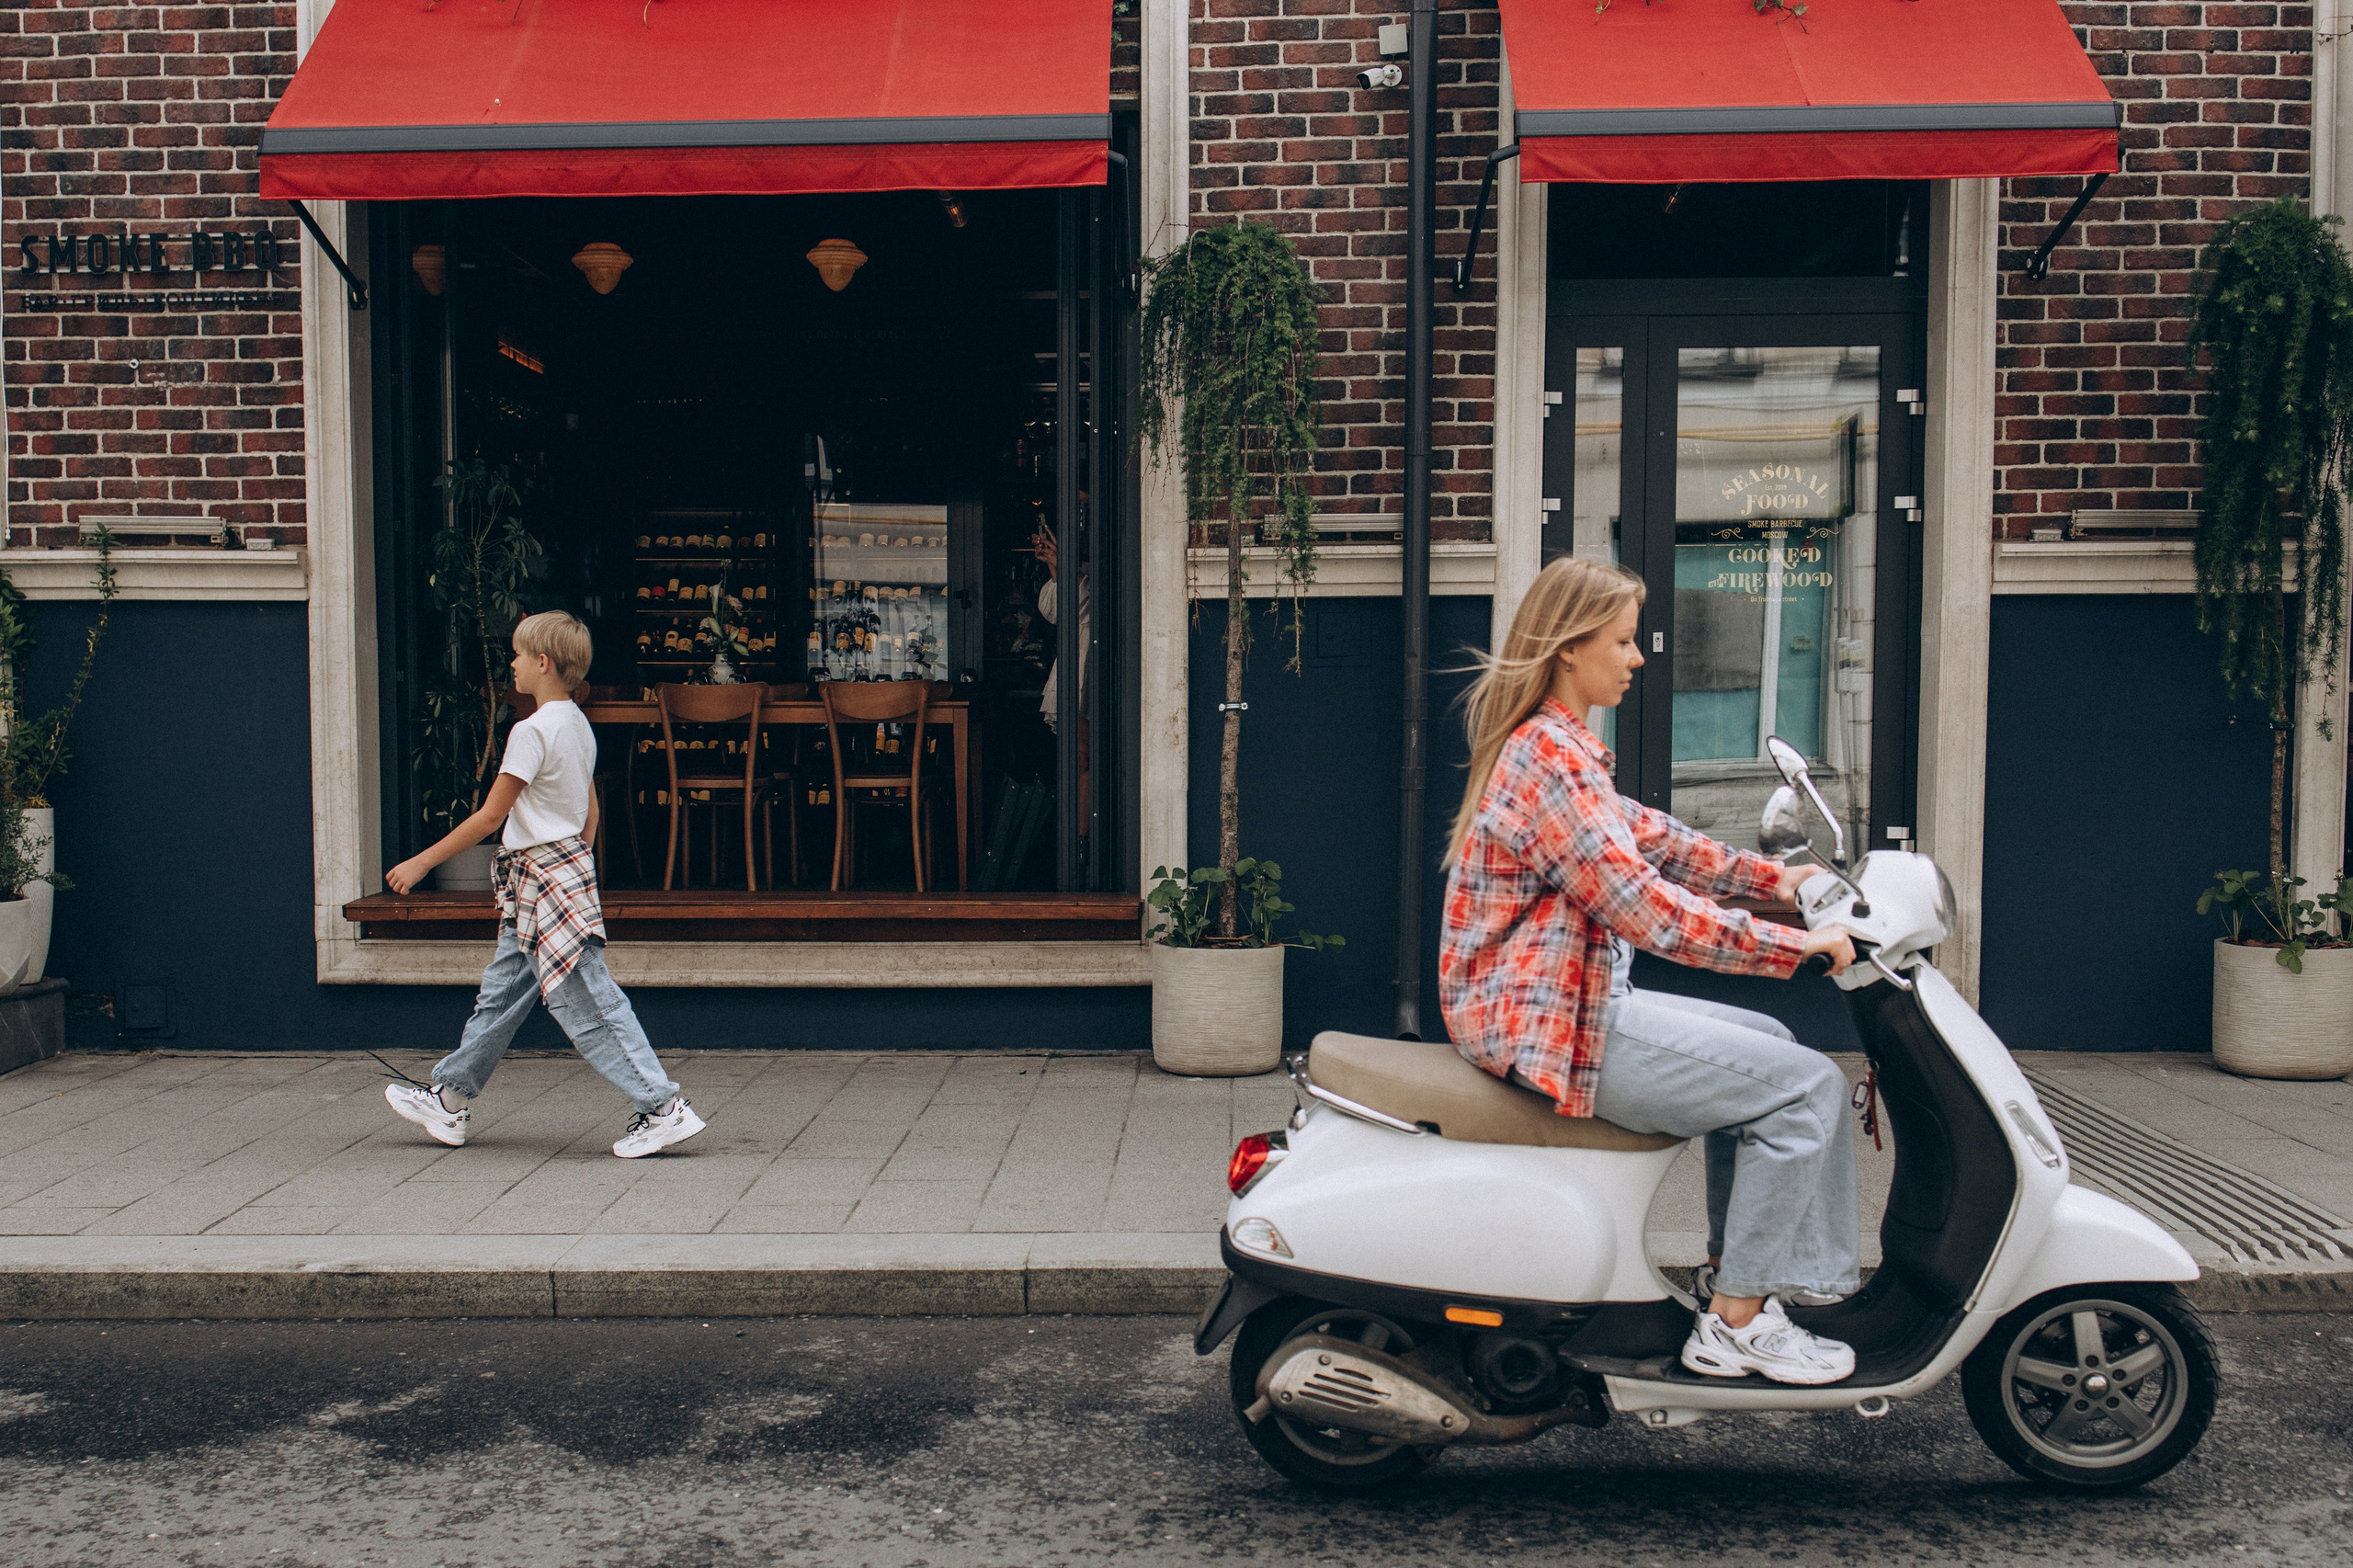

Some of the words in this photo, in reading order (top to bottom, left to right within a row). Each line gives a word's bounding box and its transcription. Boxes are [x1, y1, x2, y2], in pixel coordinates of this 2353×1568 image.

[20, 233, 170, 275] SMOKE
[191, 230, 281, 271] BBQ
[21, 295, 58, 309] БАР
[71, 292, 139, 308] ГРИЛЬ
[1722, 462, 1829, 500] SEASONAL
[1740, 494, 1809, 516] FOOD
[1747, 519, 1769, 528] SMOKE
[1770, 519, 1802, 528] BARBECUE
[1761, 530, 1789, 540] MOSCOW
[1728, 547, 1821, 570] COOKED
[1718, 572, 1833, 595] FIREWOOD
